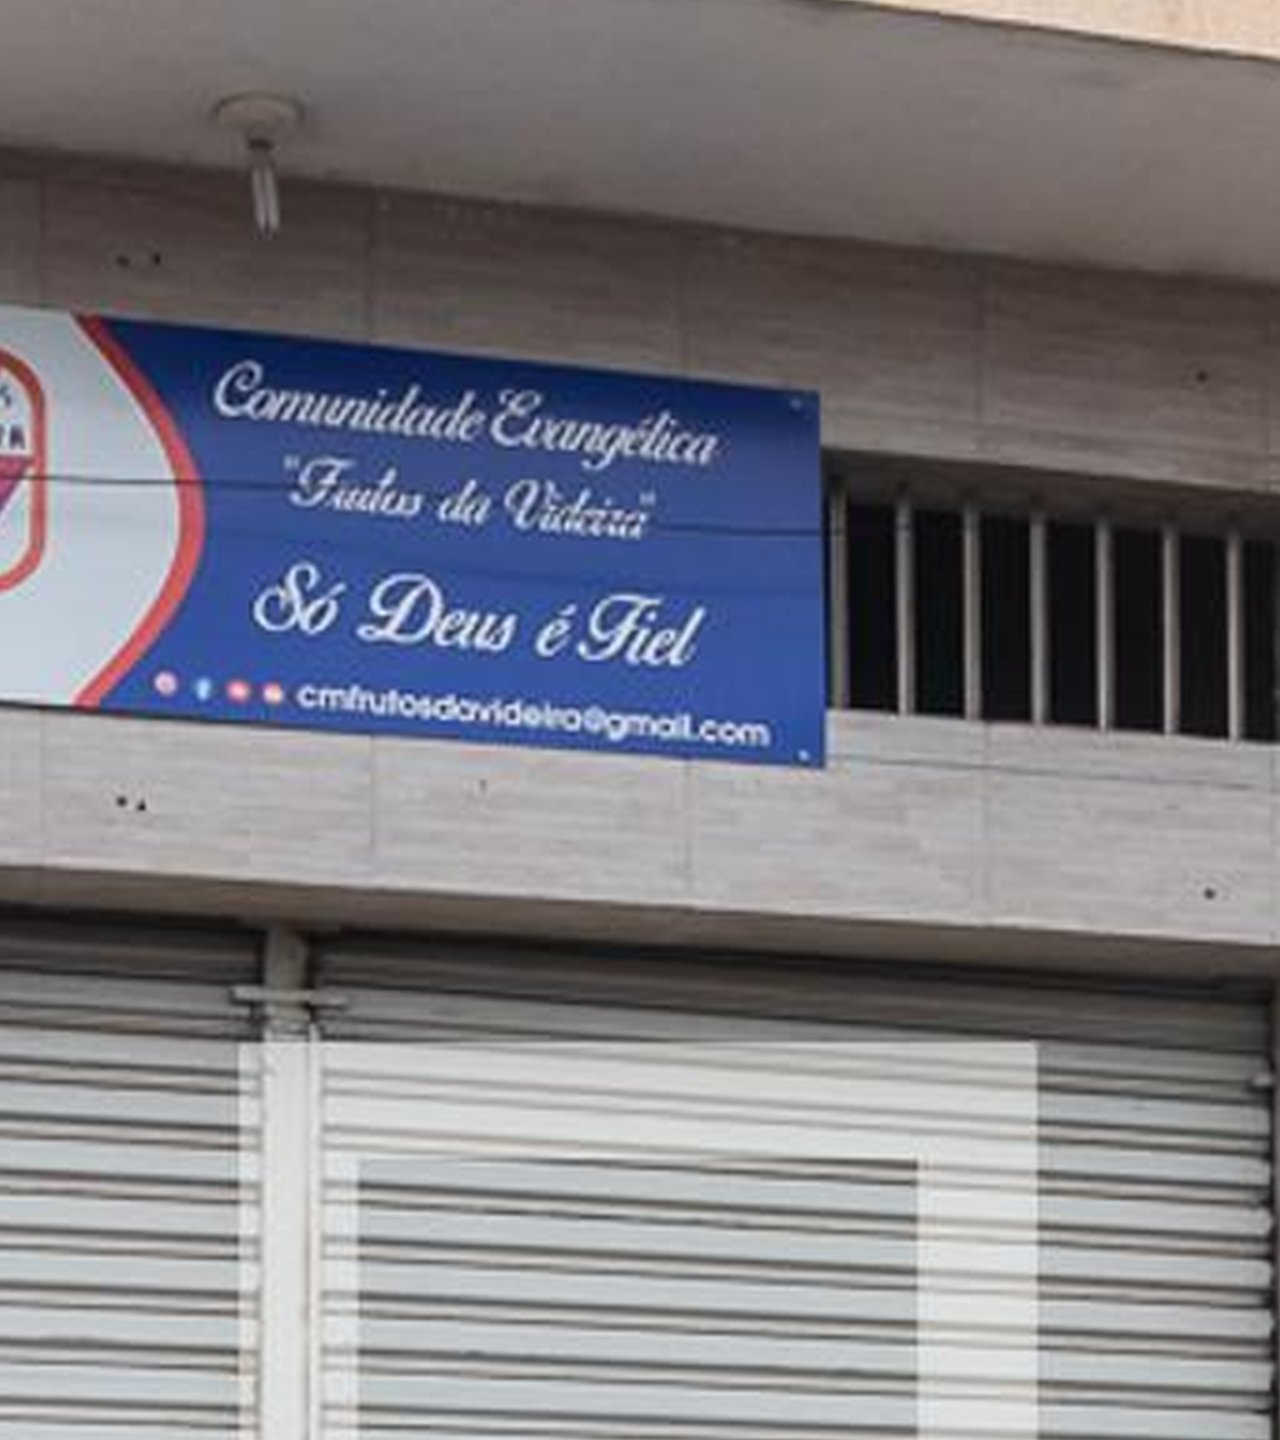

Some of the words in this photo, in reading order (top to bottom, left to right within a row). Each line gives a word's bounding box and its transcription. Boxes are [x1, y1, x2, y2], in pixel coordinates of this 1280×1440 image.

[213, 360, 486, 442] Comunidade
[489, 388, 719, 468] Evangélica
[438, 479, 491, 526] da
[252, 562, 344, 635] Só
[357, 573, 518, 652] Deus
[535, 605, 575, 658] é
[577, 594, 706, 666] Fiel
[296, 683, 771, 746] cmfrutosdavideira@gmail.com
